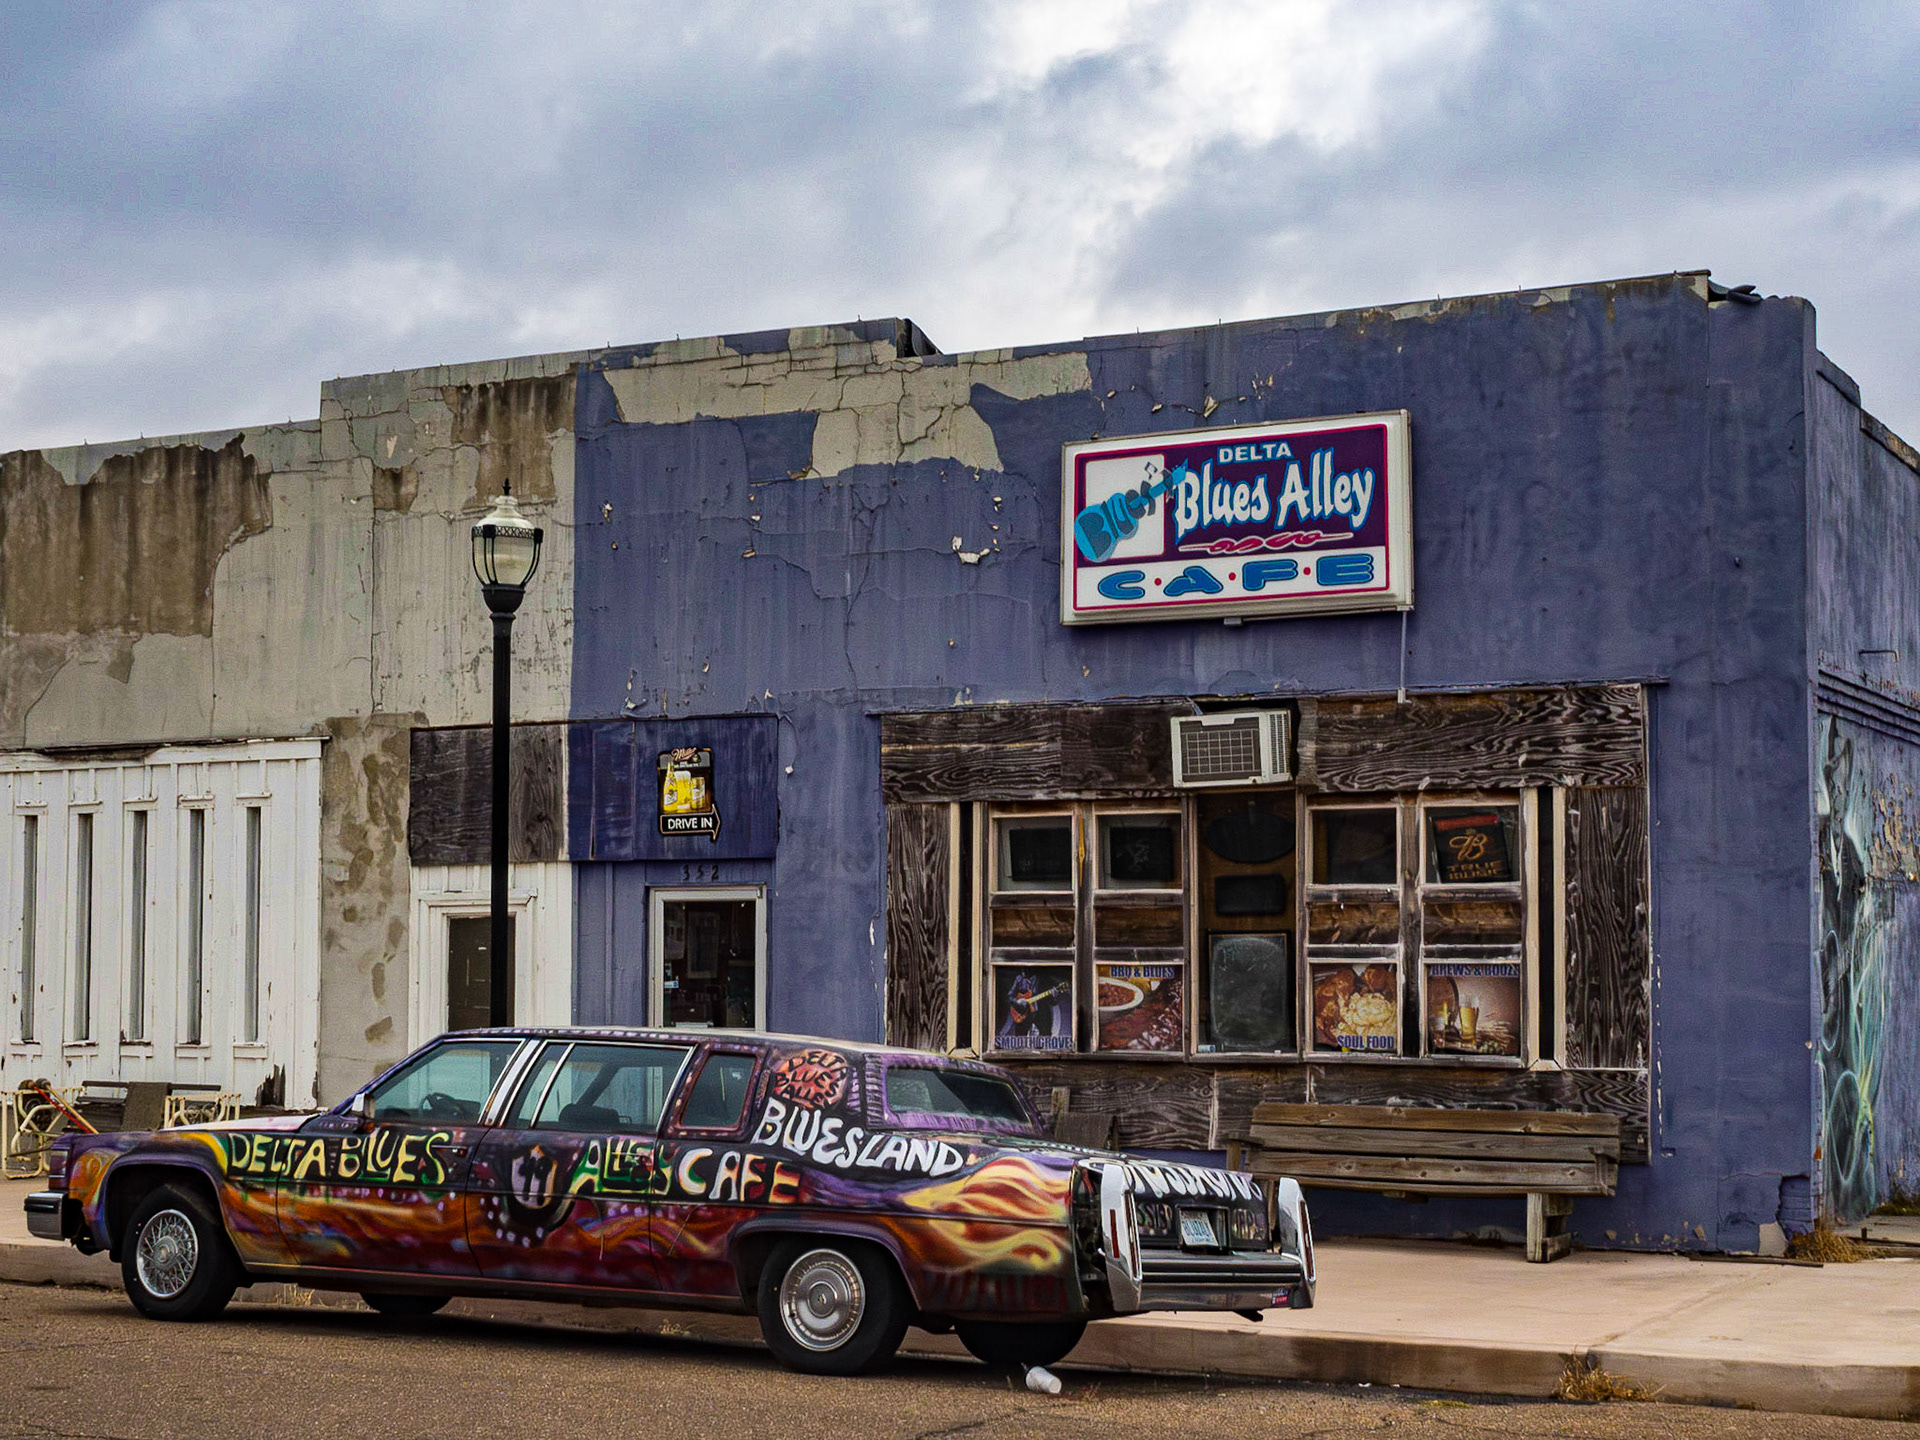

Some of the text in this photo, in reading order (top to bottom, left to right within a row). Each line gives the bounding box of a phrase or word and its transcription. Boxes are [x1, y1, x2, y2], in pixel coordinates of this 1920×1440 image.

[1217, 441, 1292, 464] DELTA
[1176, 448, 1375, 542] Blues Alley
[667, 817, 713, 830] DRIVE IN
[1110, 965, 1175, 979] BBQ & BLUES
[1431, 964, 1473, 977] BREWS
[1473, 966, 1482, 977] &
[1337, 1035, 1395, 1049] SOUL FOOD
[775, 1070, 840, 1098] BLUES
[751, 1097, 964, 1177] BLUESLAND
[227, 1133, 328, 1179] DELTA
[338, 1131, 450, 1186] BLUES
[678, 1147, 800, 1204] CAFE
